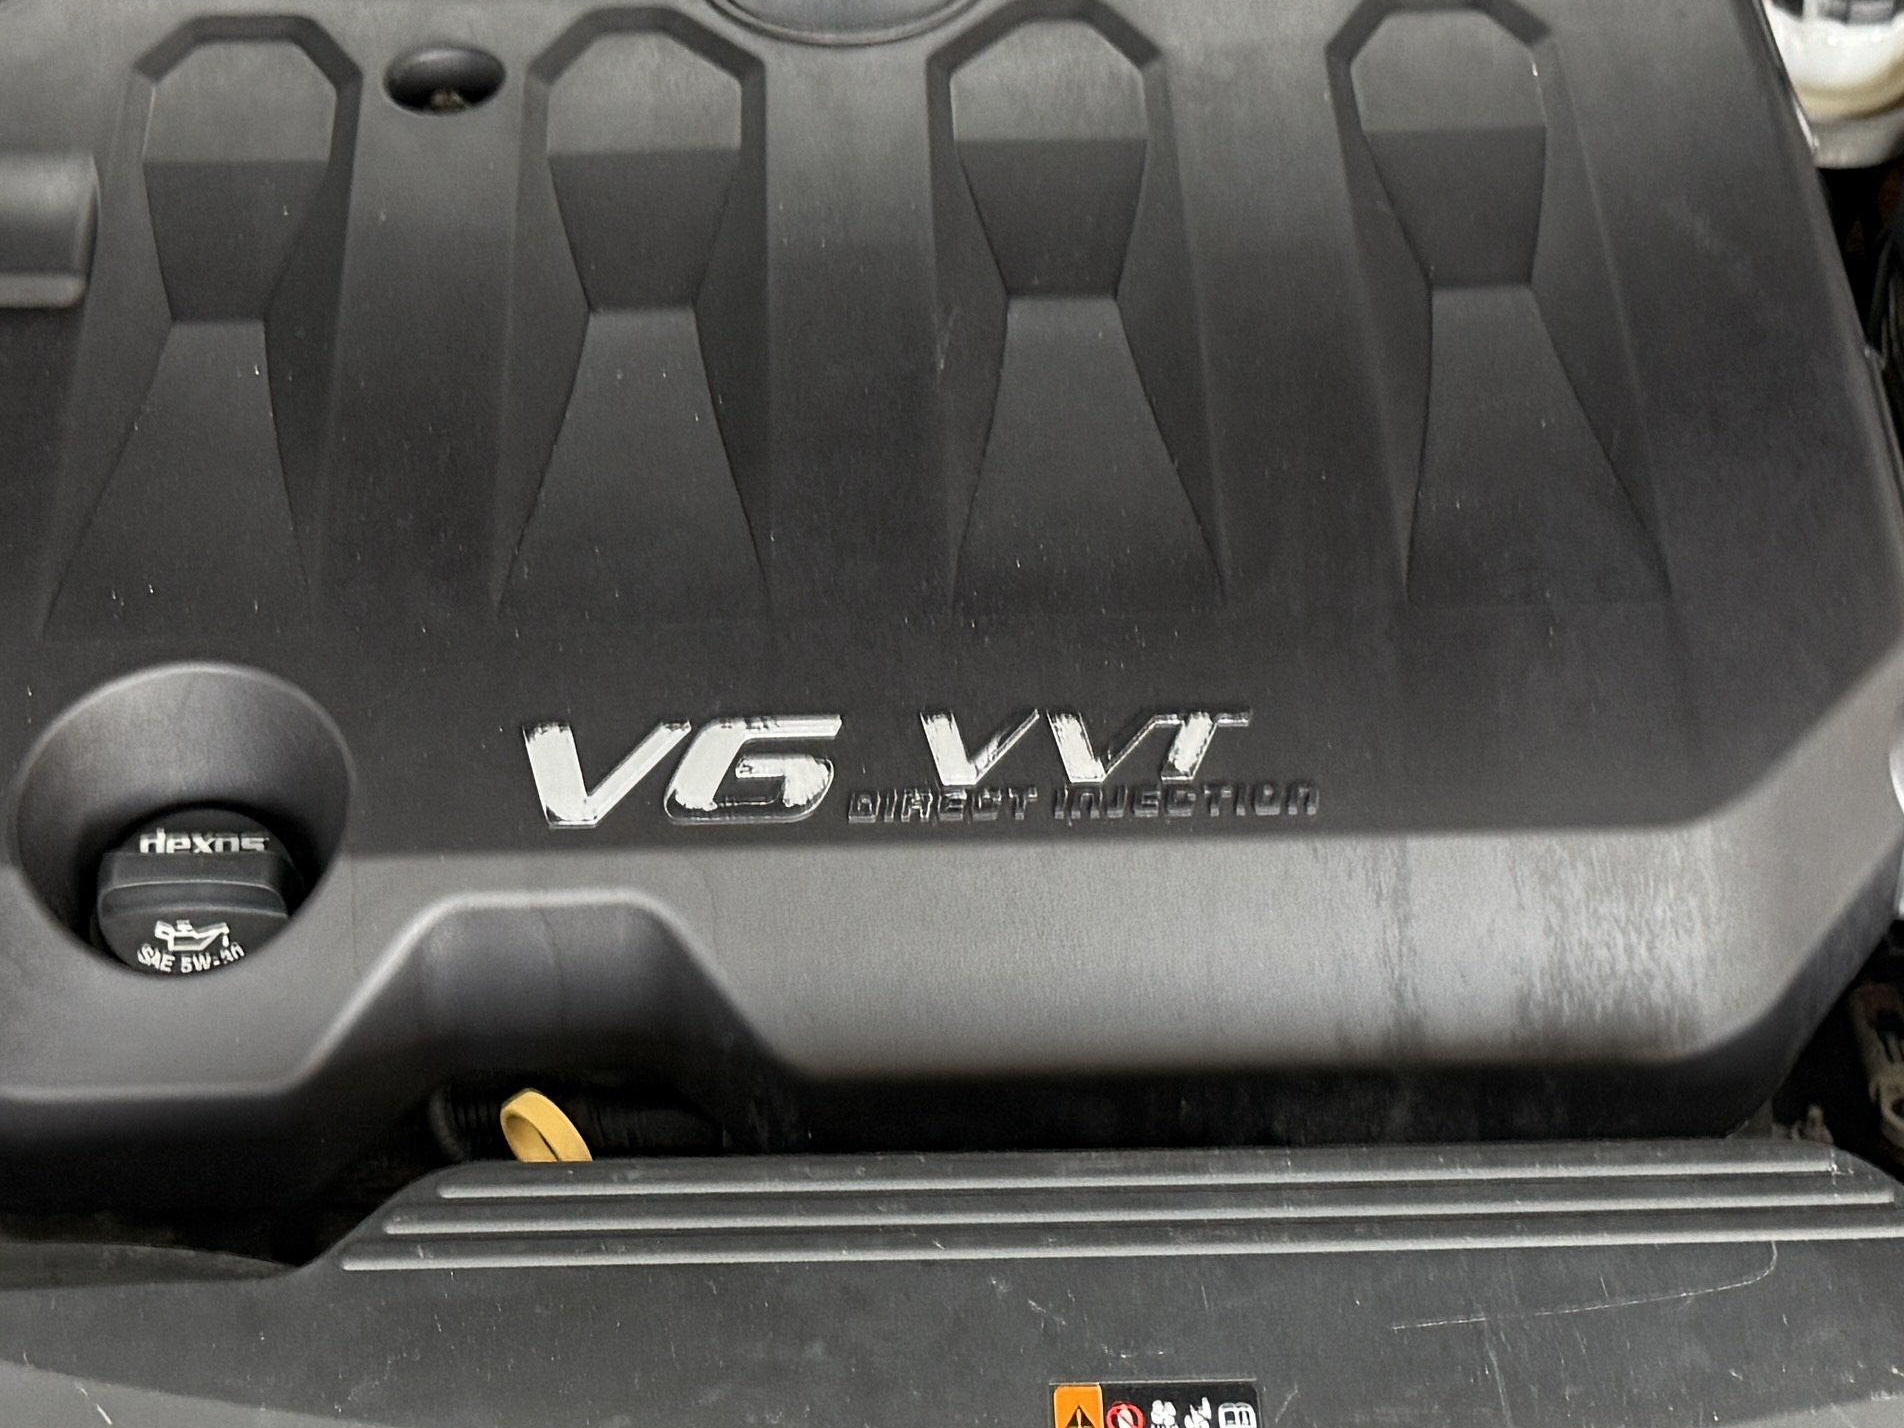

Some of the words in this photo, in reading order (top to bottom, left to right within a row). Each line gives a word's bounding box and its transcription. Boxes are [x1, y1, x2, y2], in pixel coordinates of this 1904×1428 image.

[521, 713, 844, 829] V6
[919, 708, 1254, 786] VVT
[848, 785, 1038, 824] DIRECT
[1053, 781, 1321, 820] INJECTION
[137, 943, 175, 973] SAE
